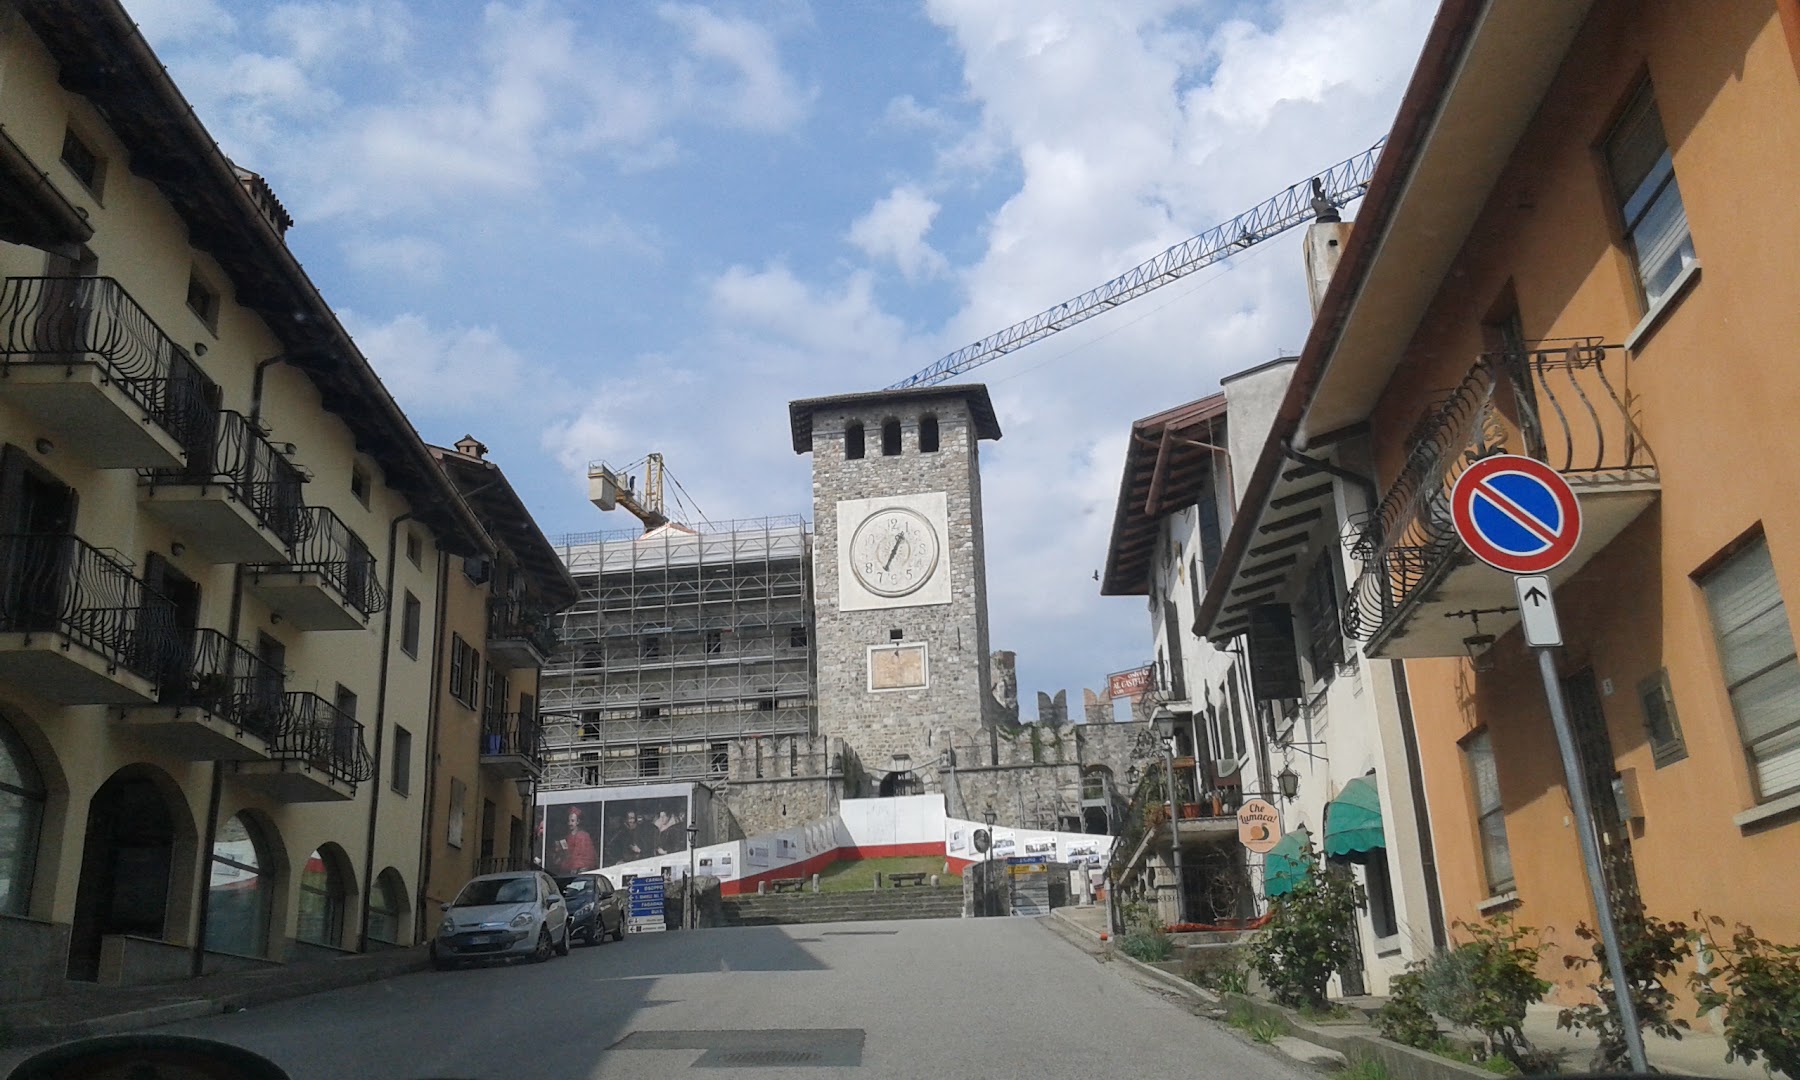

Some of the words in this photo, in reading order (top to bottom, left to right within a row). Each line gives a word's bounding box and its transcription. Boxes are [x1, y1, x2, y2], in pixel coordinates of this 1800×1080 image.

[866, 562, 872, 574] 8
[906, 568, 912, 580] 5
[877, 571, 883, 583] 7
[890, 574, 898, 586] 6
[1249, 804, 1265, 812] Che
[1240, 814, 1278, 824] Lumaca!
